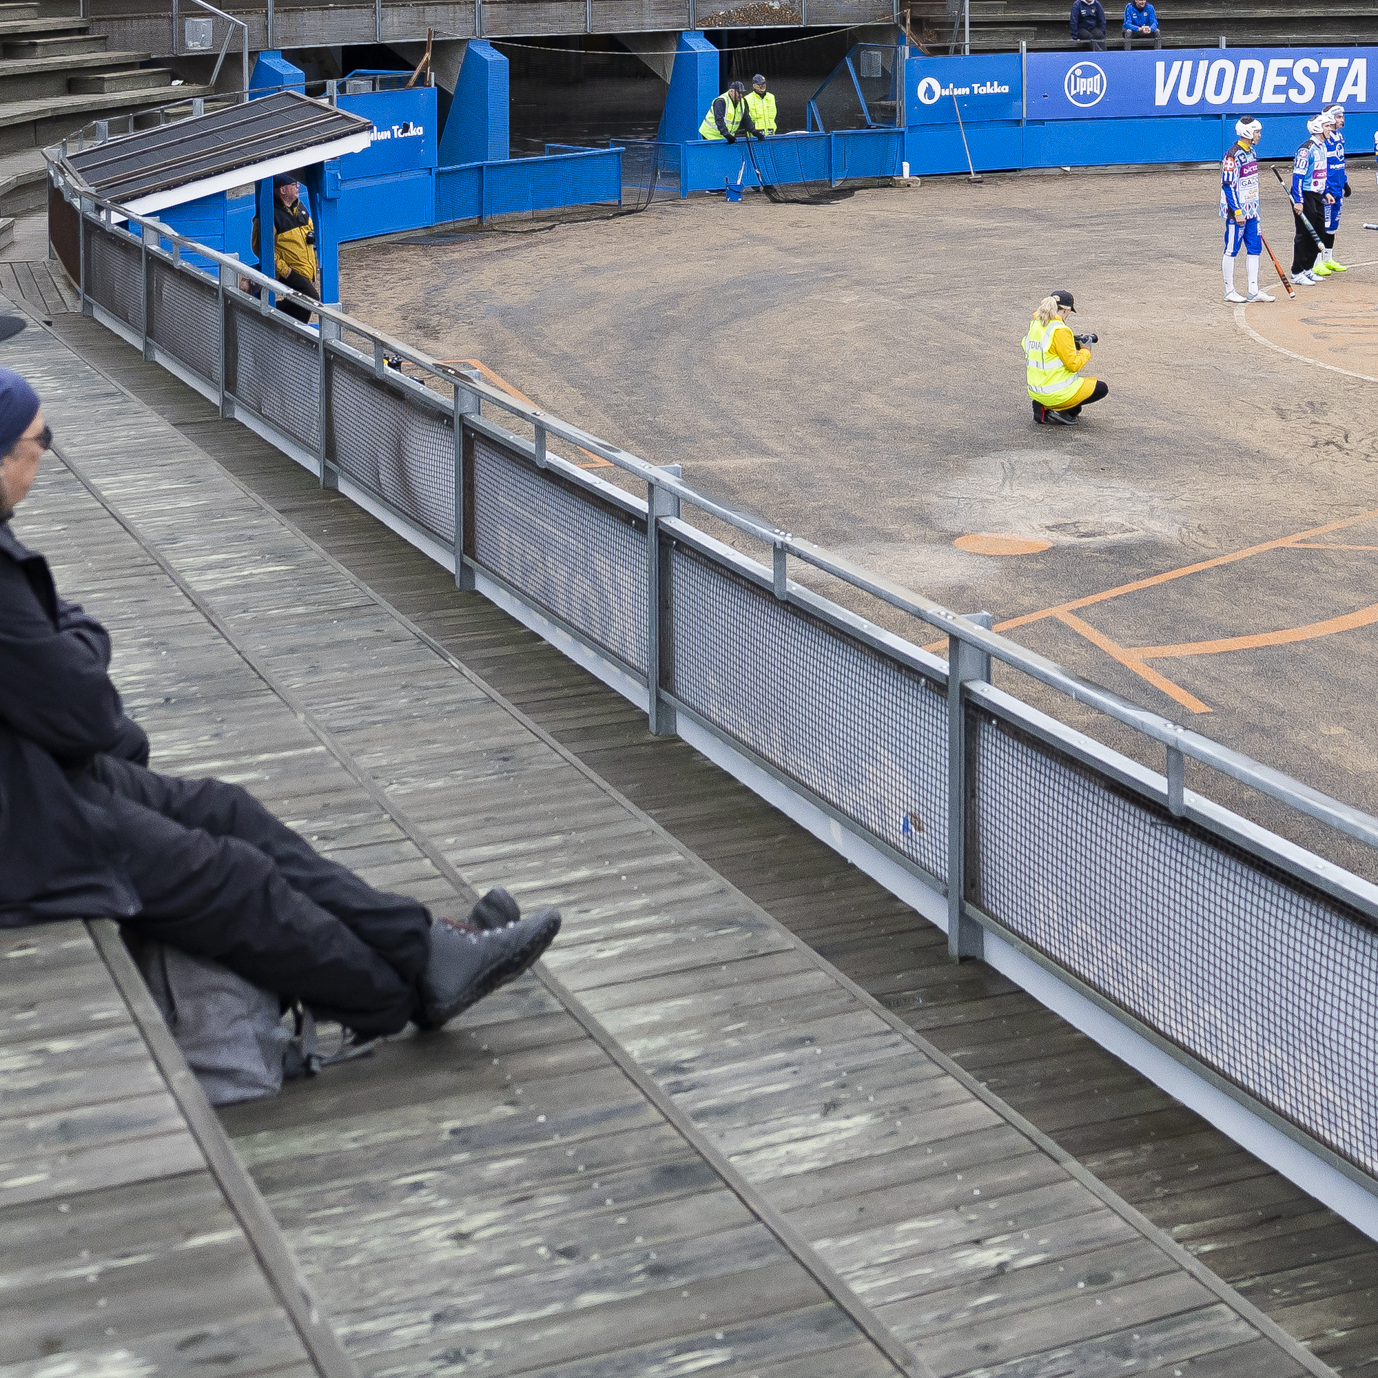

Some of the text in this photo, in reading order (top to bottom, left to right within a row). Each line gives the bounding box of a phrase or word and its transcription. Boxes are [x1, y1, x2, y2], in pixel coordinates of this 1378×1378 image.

[1154, 57, 1367, 106] VUODESTA
[971, 81, 1009, 95] Takka
[1296, 158, 1306, 169] 10
[1224, 171, 1233, 182] 11
